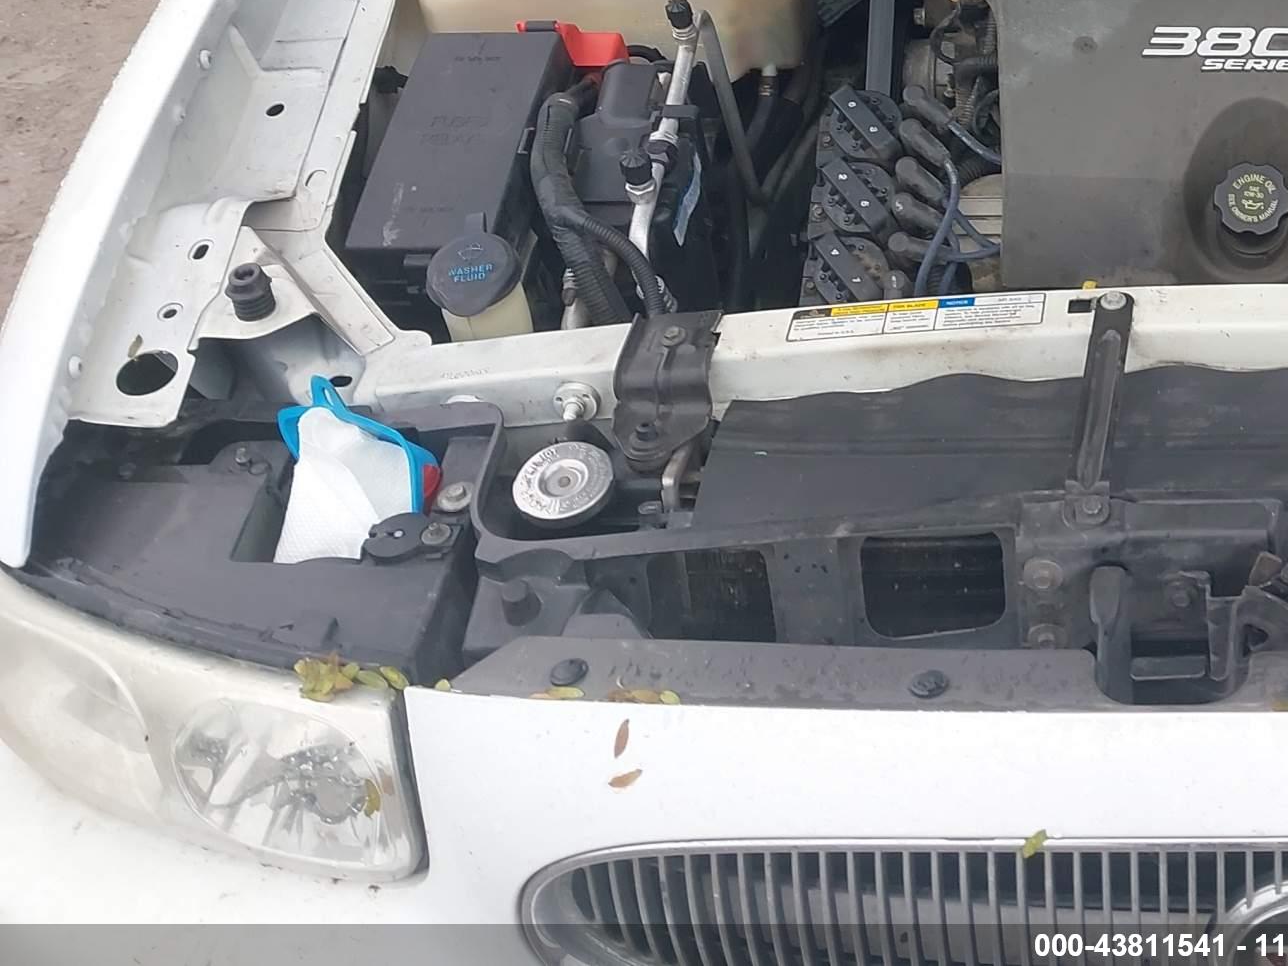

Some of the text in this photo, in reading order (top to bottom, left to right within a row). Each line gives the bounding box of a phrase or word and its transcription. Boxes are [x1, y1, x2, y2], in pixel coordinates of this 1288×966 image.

[837, 172, 849, 181] 2
[1232, 173, 1277, 195] ENGINE OIL
[1258, 199, 1279, 221] MANUAL
[447, 263, 493, 277] WASHER
[453, 272, 486, 283] FLUID
